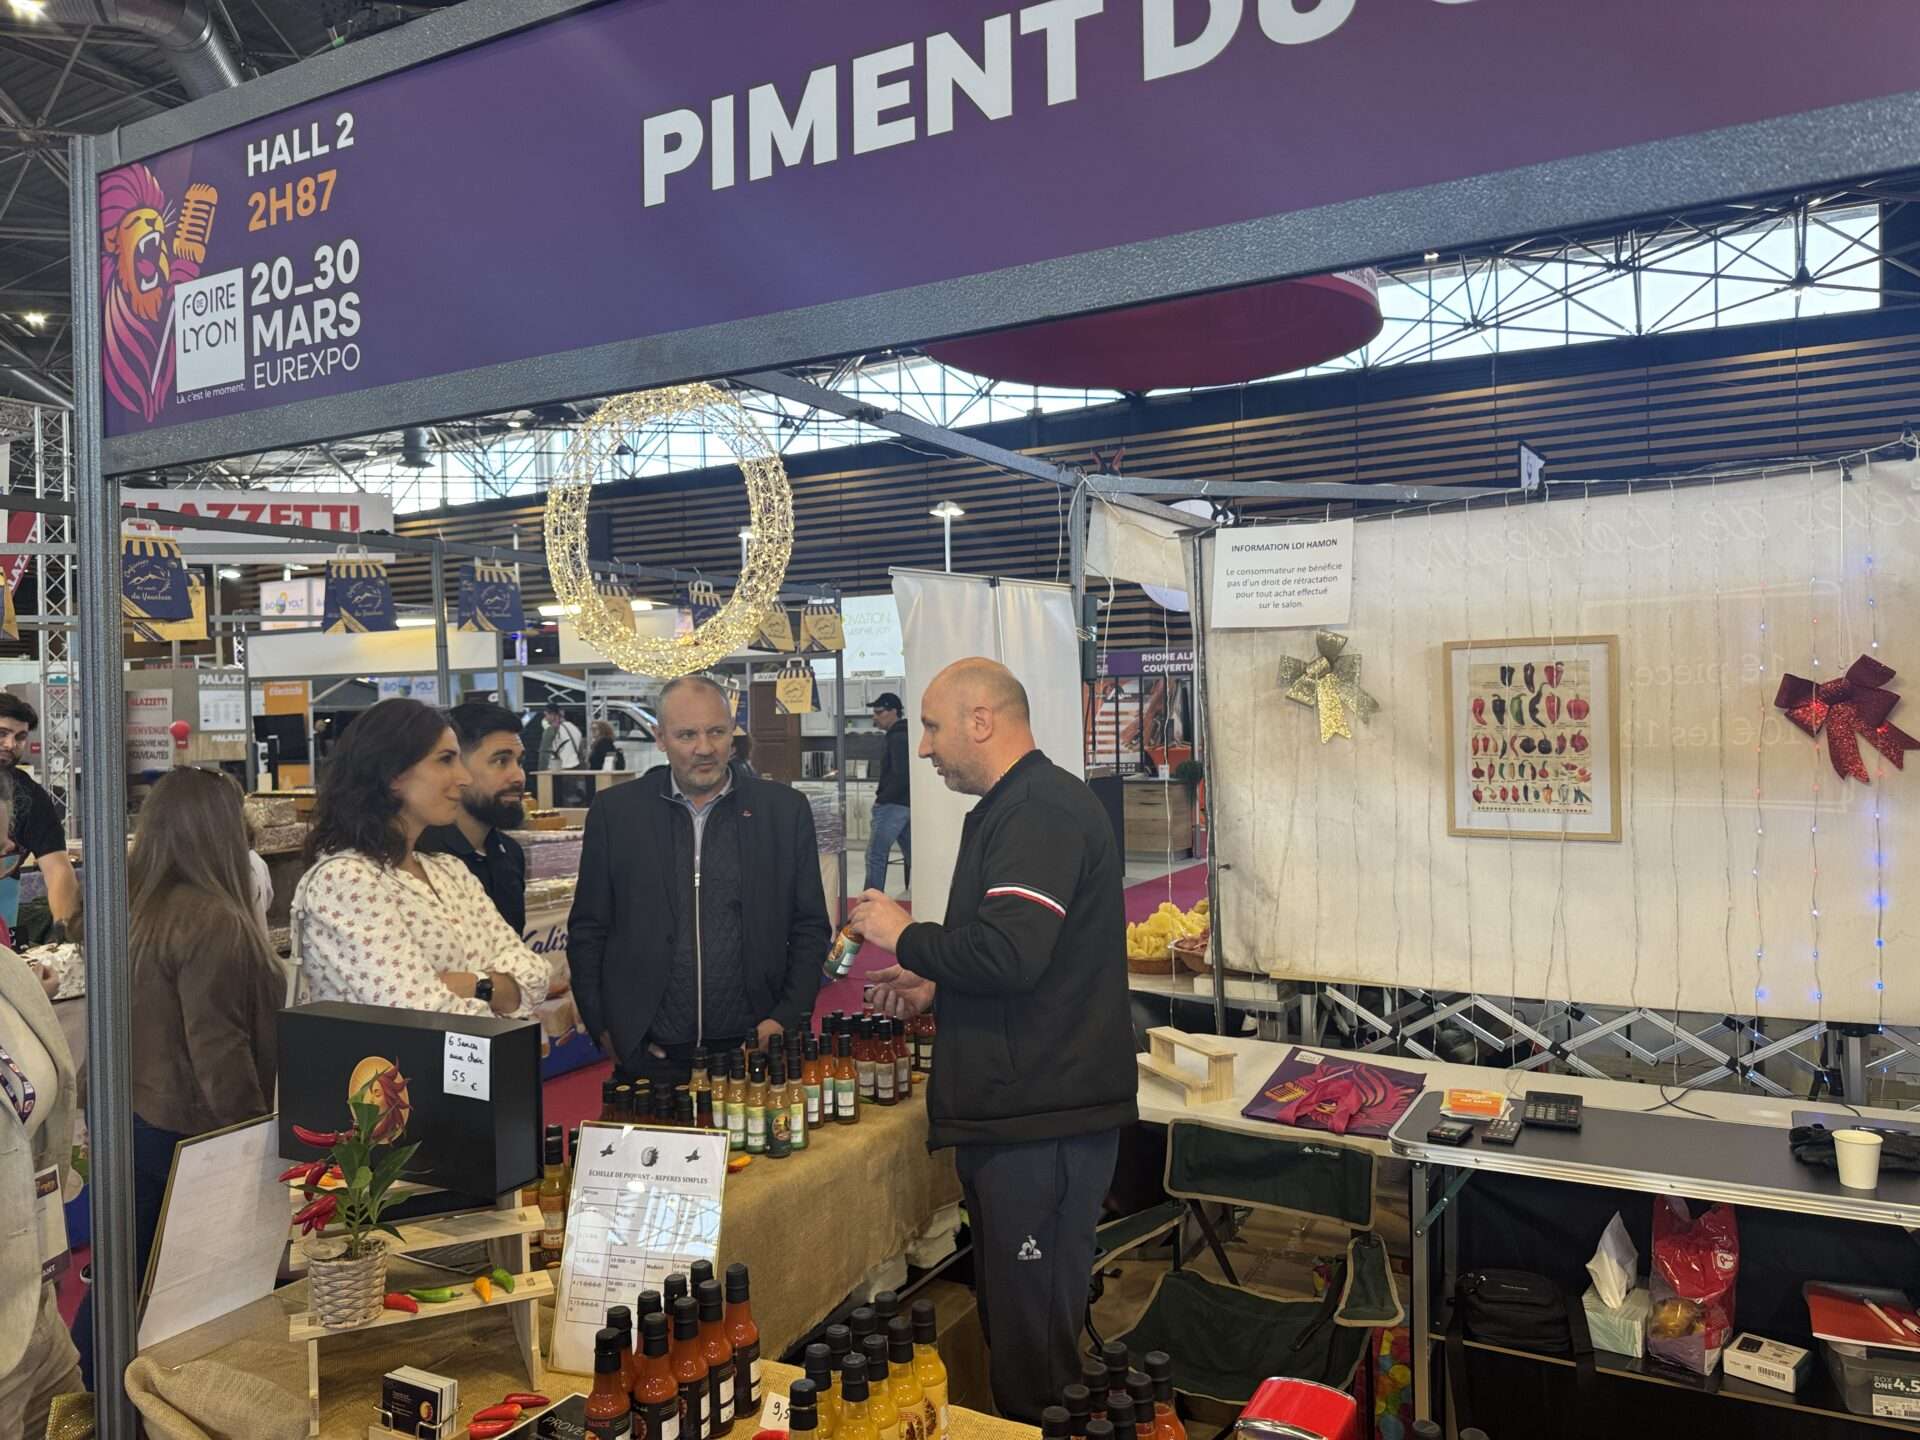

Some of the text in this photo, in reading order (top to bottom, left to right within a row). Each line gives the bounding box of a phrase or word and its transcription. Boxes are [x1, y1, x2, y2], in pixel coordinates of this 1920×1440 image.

[642, 0, 1106, 208] PIMENT
[247, 112, 355, 177] HALL 2
[247, 168, 337, 232] 2H87
[250, 238, 361, 307] 20_30
[182, 282, 236, 321] FOIRE
[183, 317, 237, 354] LYON
[252, 291, 361, 357] MARS
[253, 343, 361, 390] EUREXPO
[204, 388, 212, 399] le
[1231, 538, 1338, 553] INFORMATION LOI HAMON
[1226, 568, 1235, 576] Le
[1236, 567, 1295, 577] consommateur
[1297, 566, 1307, 574] ne
[1227, 580, 1241, 589] pas
[1242, 578, 1260, 588] d'un
[1261, 577, 1280, 587] droit
[1281, 576, 1292, 585] de
[1235, 591, 1255, 599] pour
[1256, 590, 1272, 598] tout
[1273, 588, 1295, 598] achat
[1272, 601, 1280, 609] le
[1873, 1375, 1893, 1383] BOX
[1873, 1382, 1894, 1390] ONE
